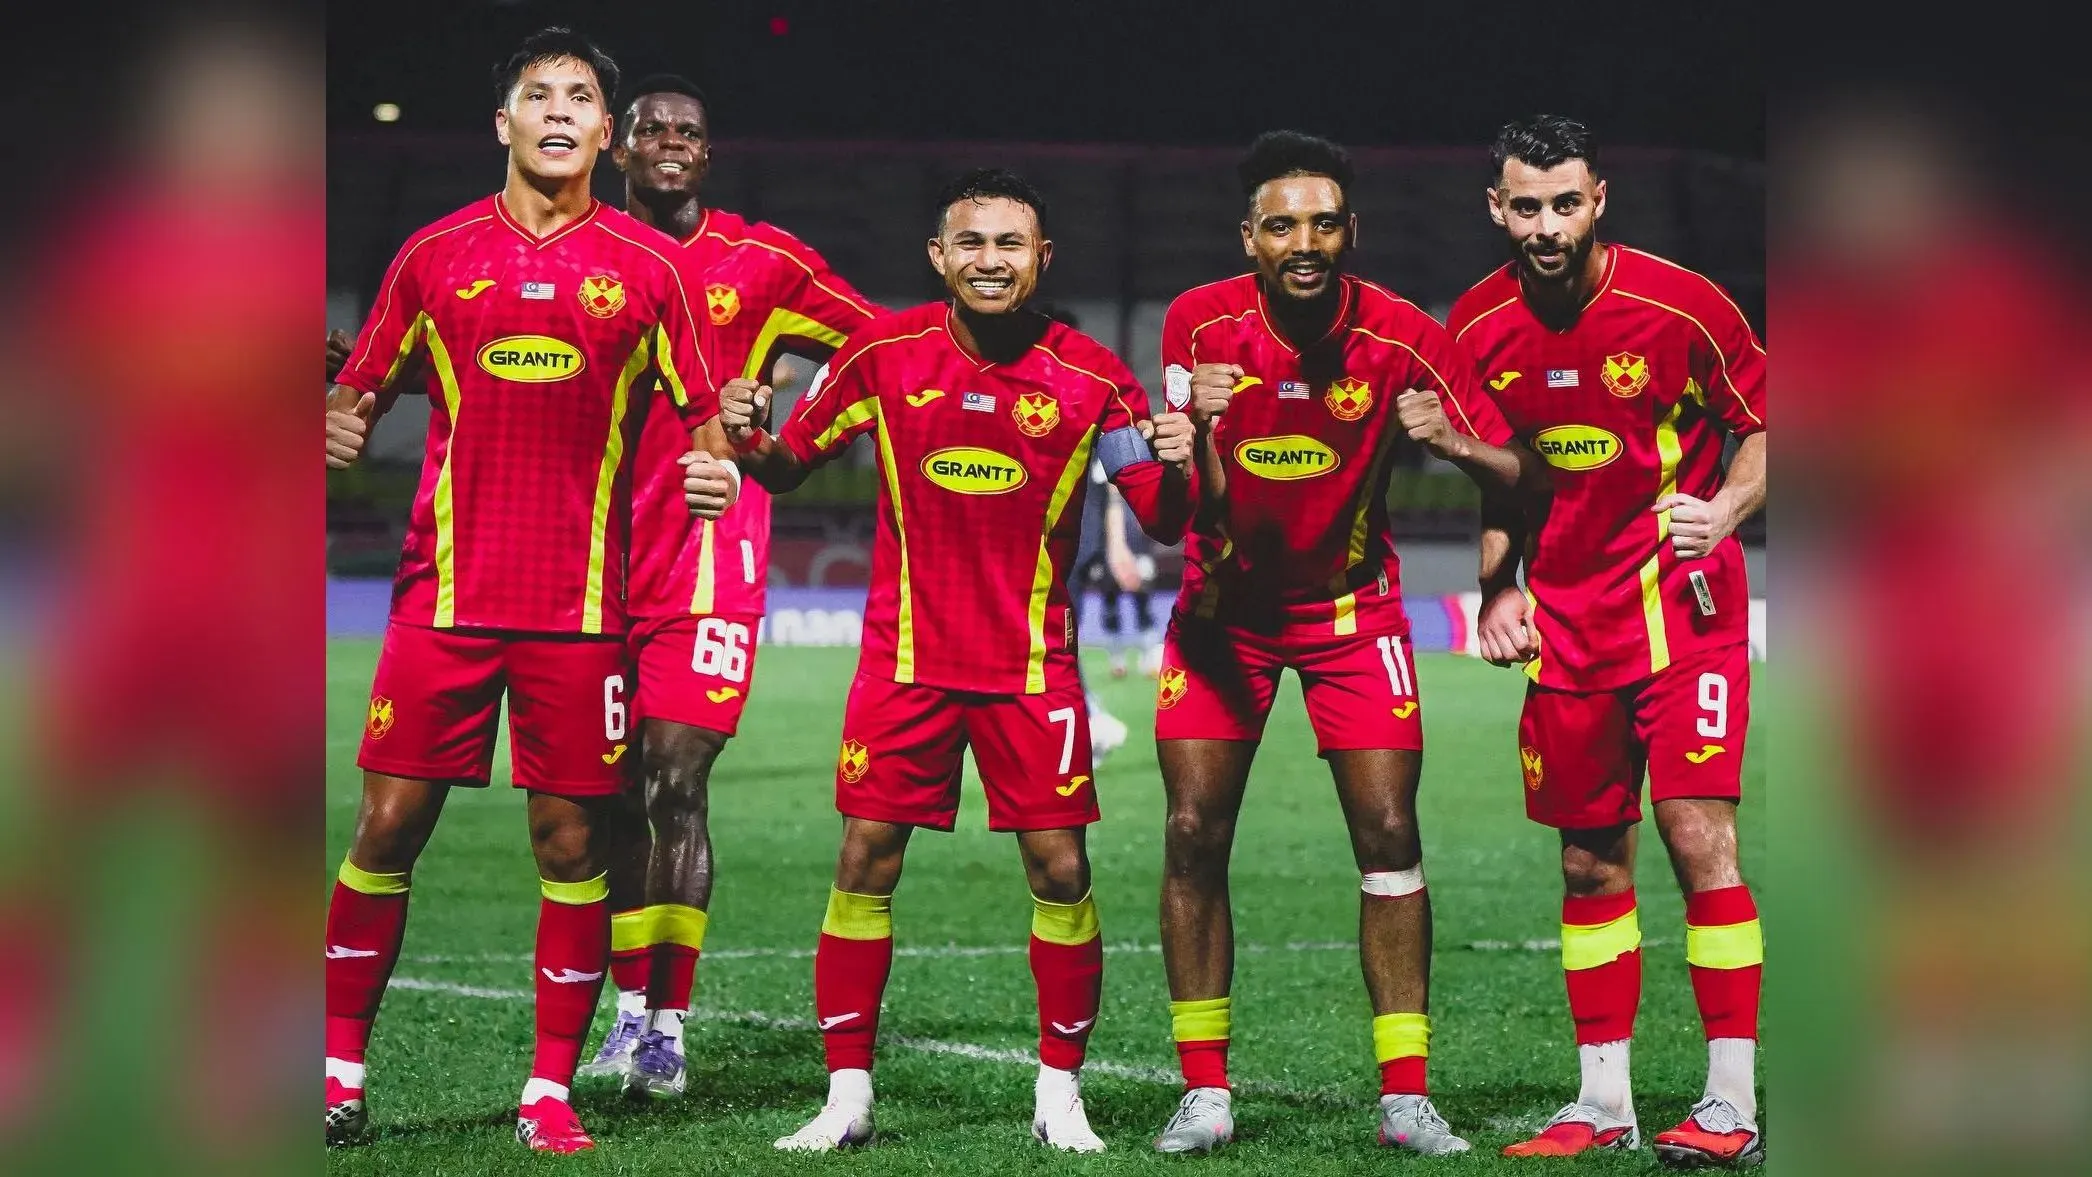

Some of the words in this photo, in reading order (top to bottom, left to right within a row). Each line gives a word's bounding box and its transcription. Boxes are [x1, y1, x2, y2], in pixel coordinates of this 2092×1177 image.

[488, 350, 574, 369] GRANTT
[932, 460, 1017, 482] GRANTT
[1245, 448, 1328, 466] GRANTT
[691, 617, 749, 683] 66
[1376, 635, 1413, 697] 11
[604, 674, 626, 741] 6
[1696, 672, 1728, 739] 9
[1047, 706, 1076, 775] 7
